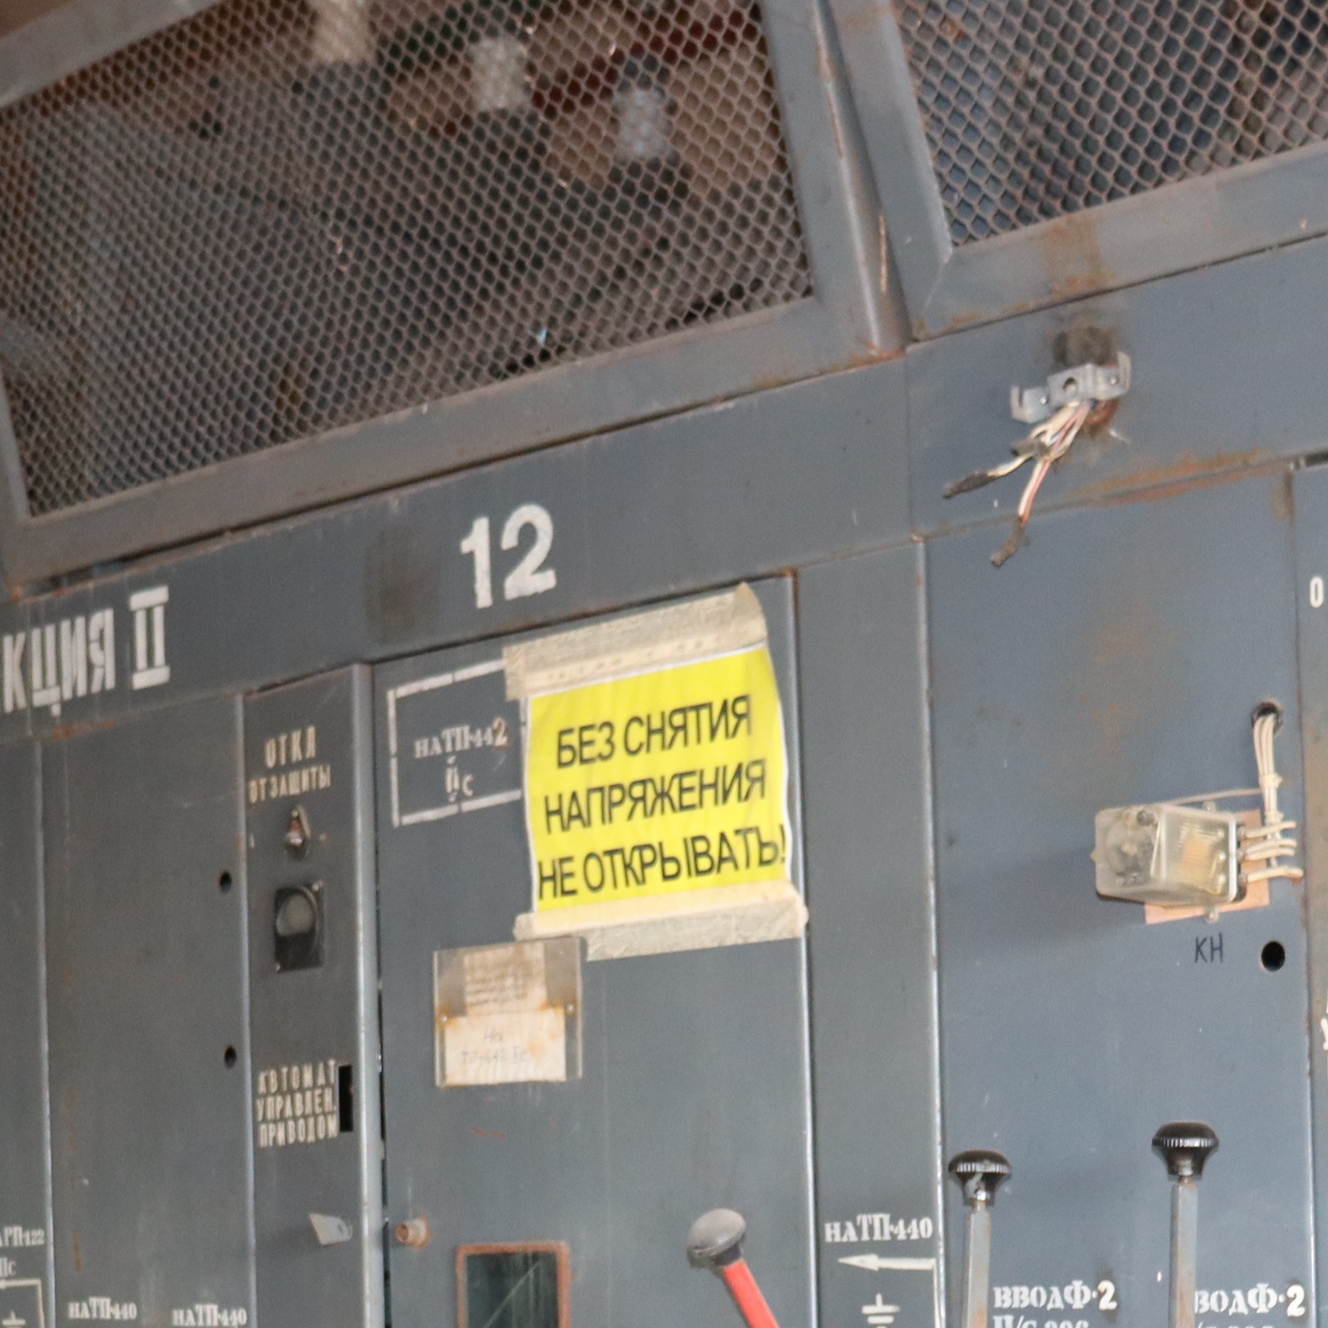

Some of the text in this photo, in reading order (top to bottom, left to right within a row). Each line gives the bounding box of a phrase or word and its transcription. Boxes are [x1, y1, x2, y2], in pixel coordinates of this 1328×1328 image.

[460, 503, 558, 609] 12
[265, 725, 317, 770] ОТКЛ
[556, 692, 751, 769] БЕЗ СНЯТИЯ
[545, 757, 767, 836] НАПРЯЖЕНИЯ
[537, 822, 787, 901] НЕ ОТКРЫВАТЬ!
[258, 1059, 337, 1095] АВТОМАТ
[258, 1112, 339, 1148] ПРИВОДОМ
